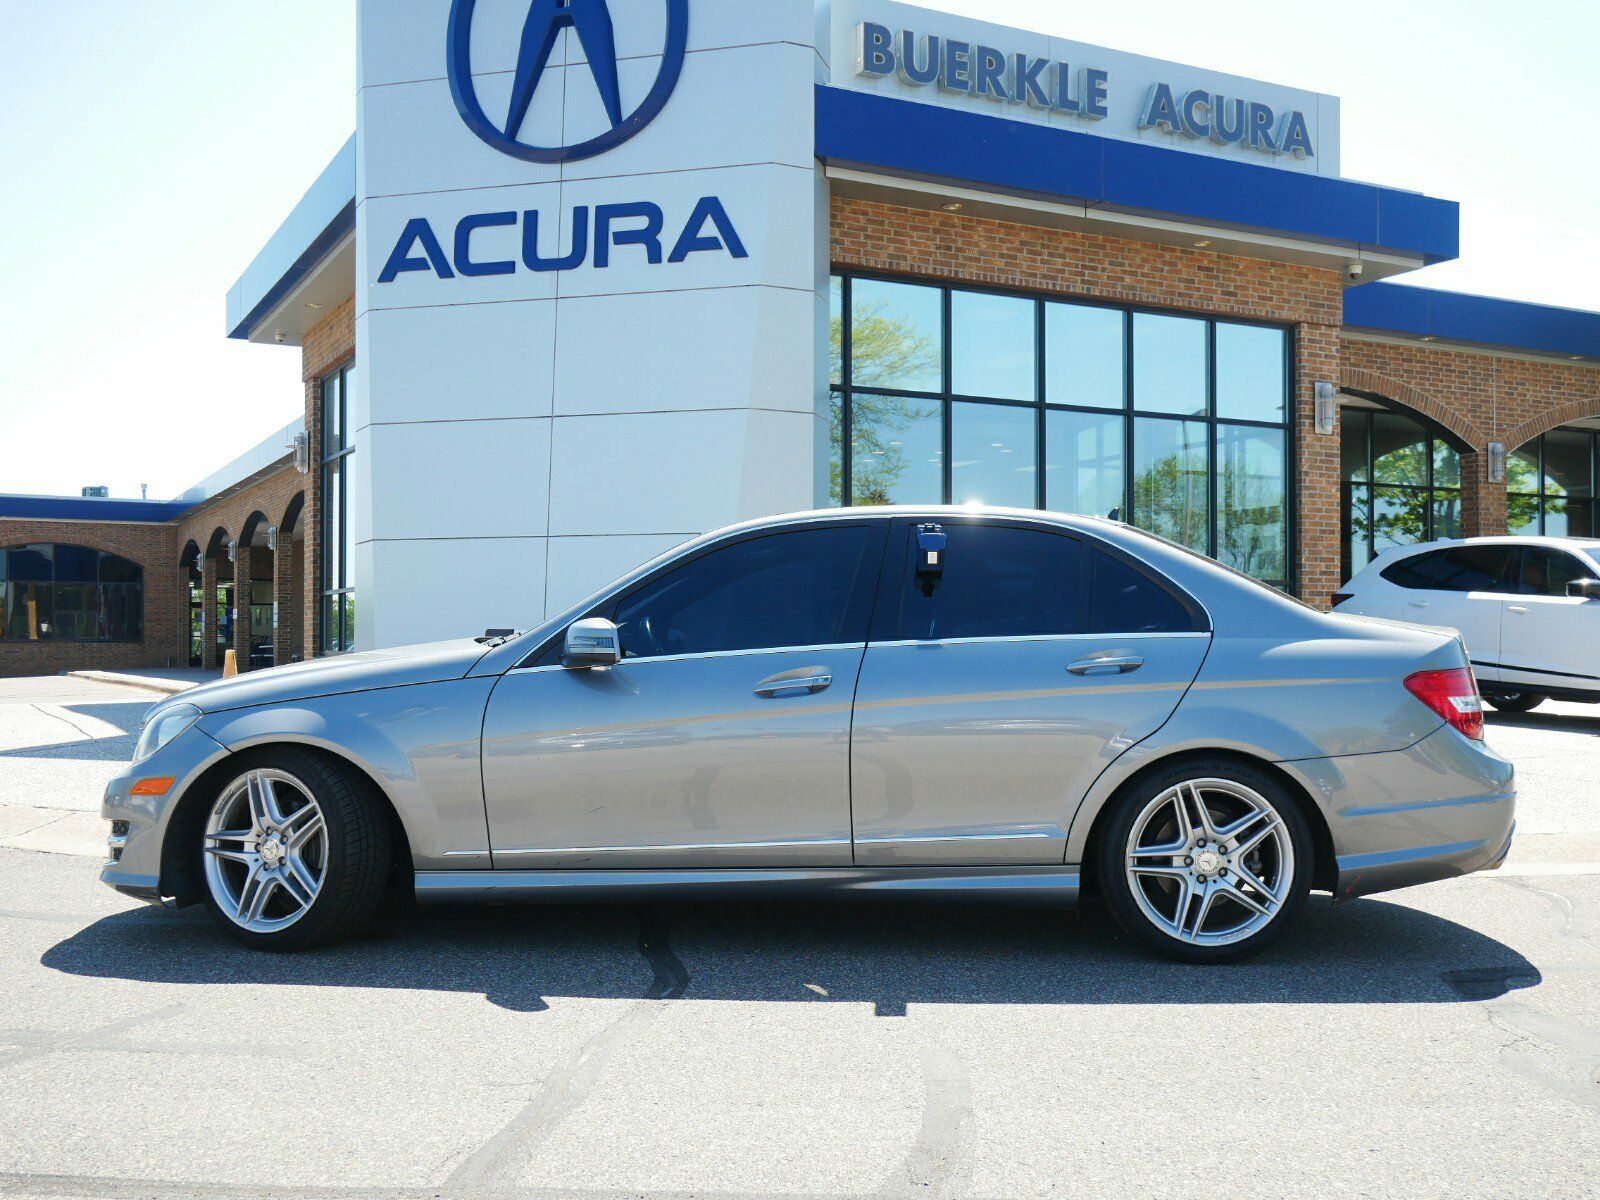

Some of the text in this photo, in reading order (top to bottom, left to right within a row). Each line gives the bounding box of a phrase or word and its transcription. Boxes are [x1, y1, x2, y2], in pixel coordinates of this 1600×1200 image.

[856, 21, 1315, 158] BUERKLE ACURA
[377, 196, 748, 283] ACURA
